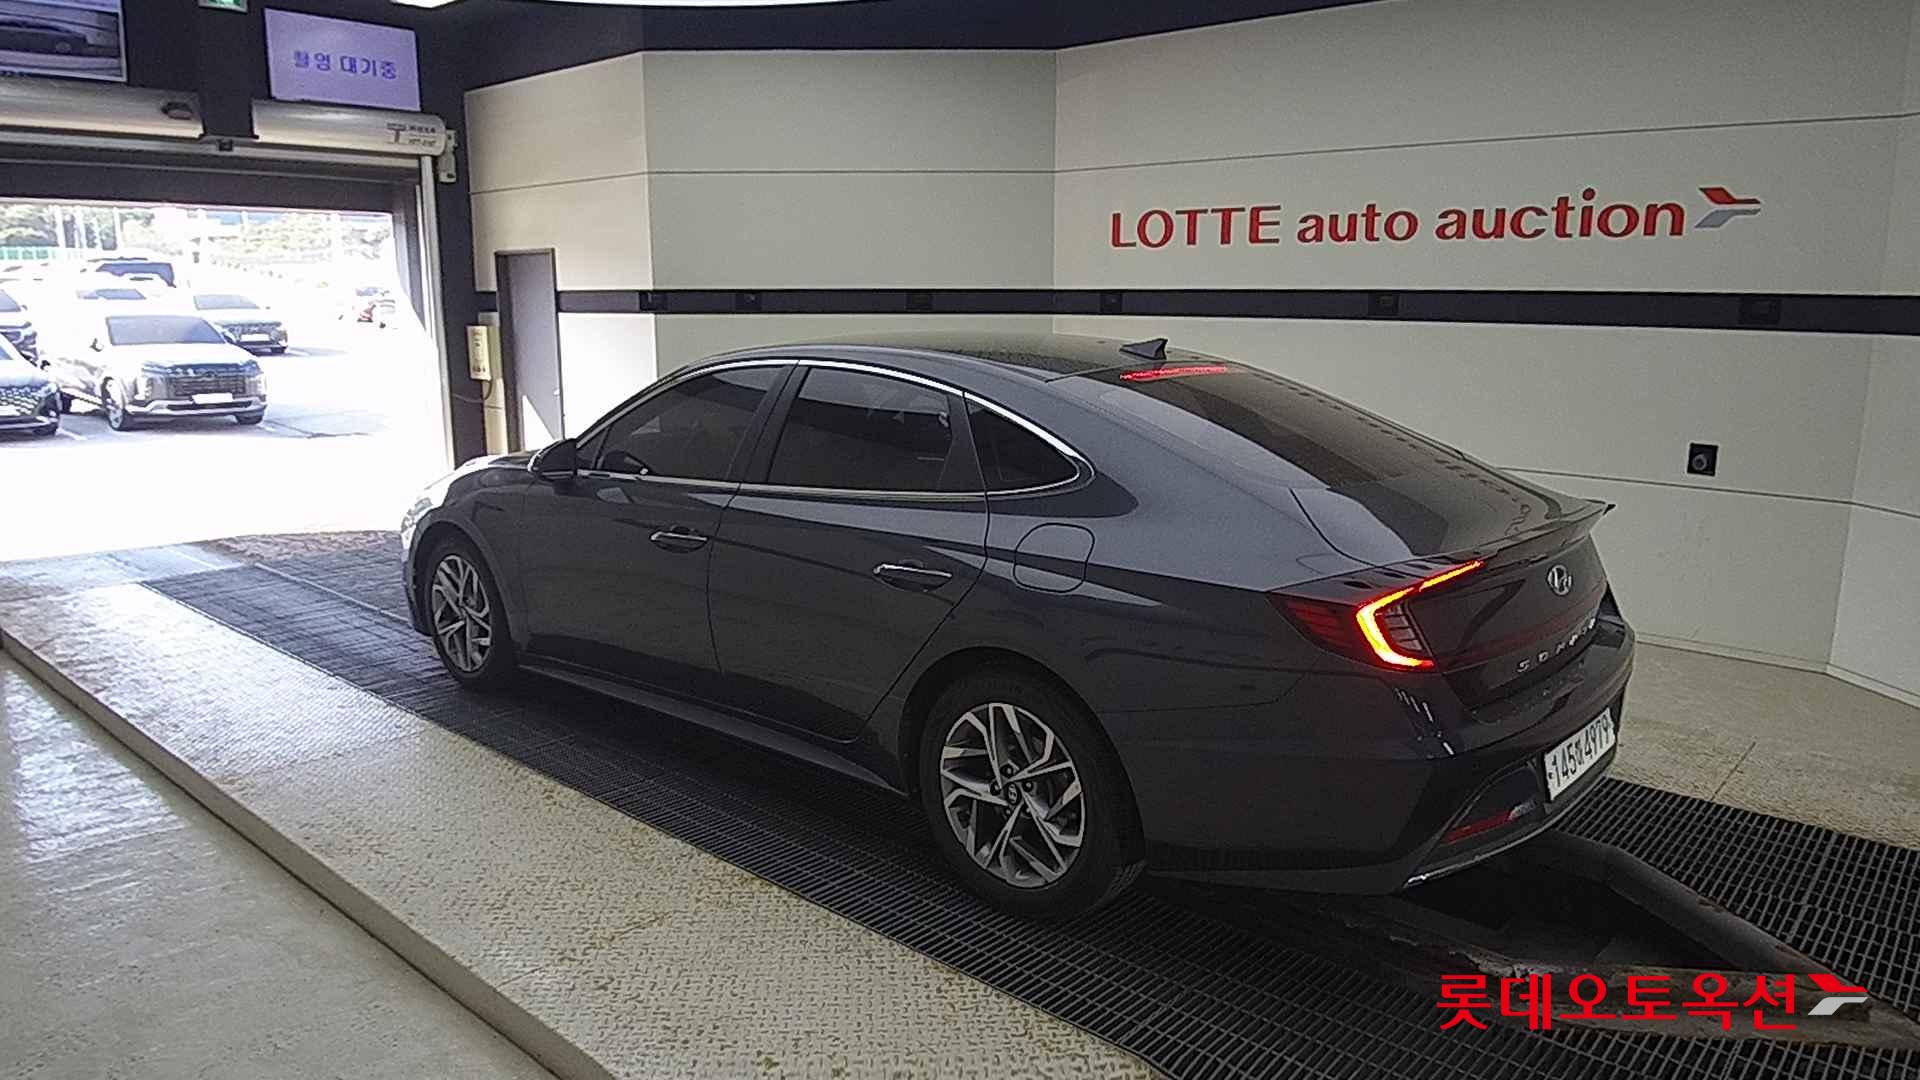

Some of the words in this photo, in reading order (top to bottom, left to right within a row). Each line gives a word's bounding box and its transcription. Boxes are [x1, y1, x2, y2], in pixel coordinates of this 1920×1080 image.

[340, 55, 397, 79] 대기중
[1111, 205, 1282, 248] LOTTE
[1298, 203, 1418, 244] auto
[1436, 188, 1685, 240] auction
